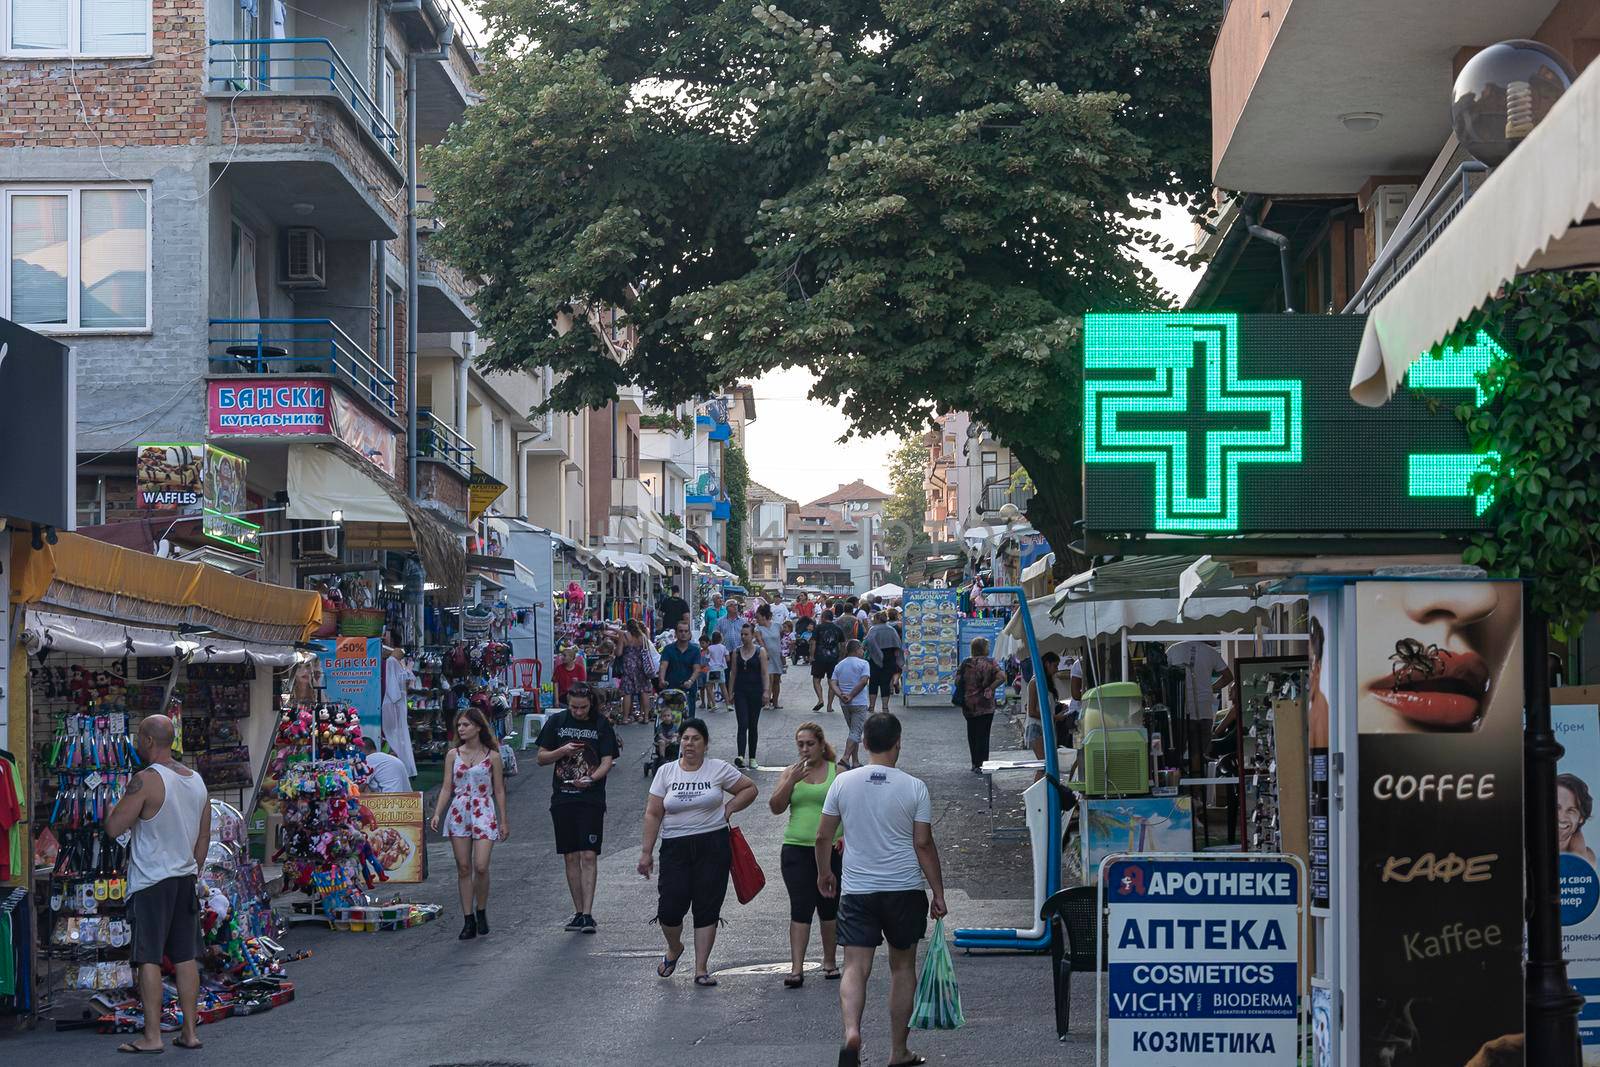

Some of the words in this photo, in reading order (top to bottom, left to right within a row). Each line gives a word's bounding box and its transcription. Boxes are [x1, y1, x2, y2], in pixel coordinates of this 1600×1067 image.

[219, 388, 325, 410] БАНСКИ
[221, 414, 324, 426] КУПАЛЬНИКИ
[143, 492, 197, 504] WAFFLES
[340, 643, 364, 652] -50%
[325, 659, 377, 668] БАНСКИ
[1555, 722, 1585, 734] Крем
[671, 781, 711, 791] COTTON
[1373, 774, 1496, 802] COFFEE
[374, 811, 415, 821] ONUTS
[1382, 852, 1498, 883] КАФЕ
[1148, 872, 1291, 896] APOTHEKE
[1569, 876, 1592, 884] своя
[1118, 918, 1287, 950] АПТЕКА
[1403, 923, 1502, 961] Kaffee
[1132, 965, 1274, 984] COSMETICS
[1113, 993, 1194, 1012] VICHY
[1213, 993, 1293, 1007] BIODERMA
[1133, 1031, 1276, 1054] КОЗМЕТИКА
